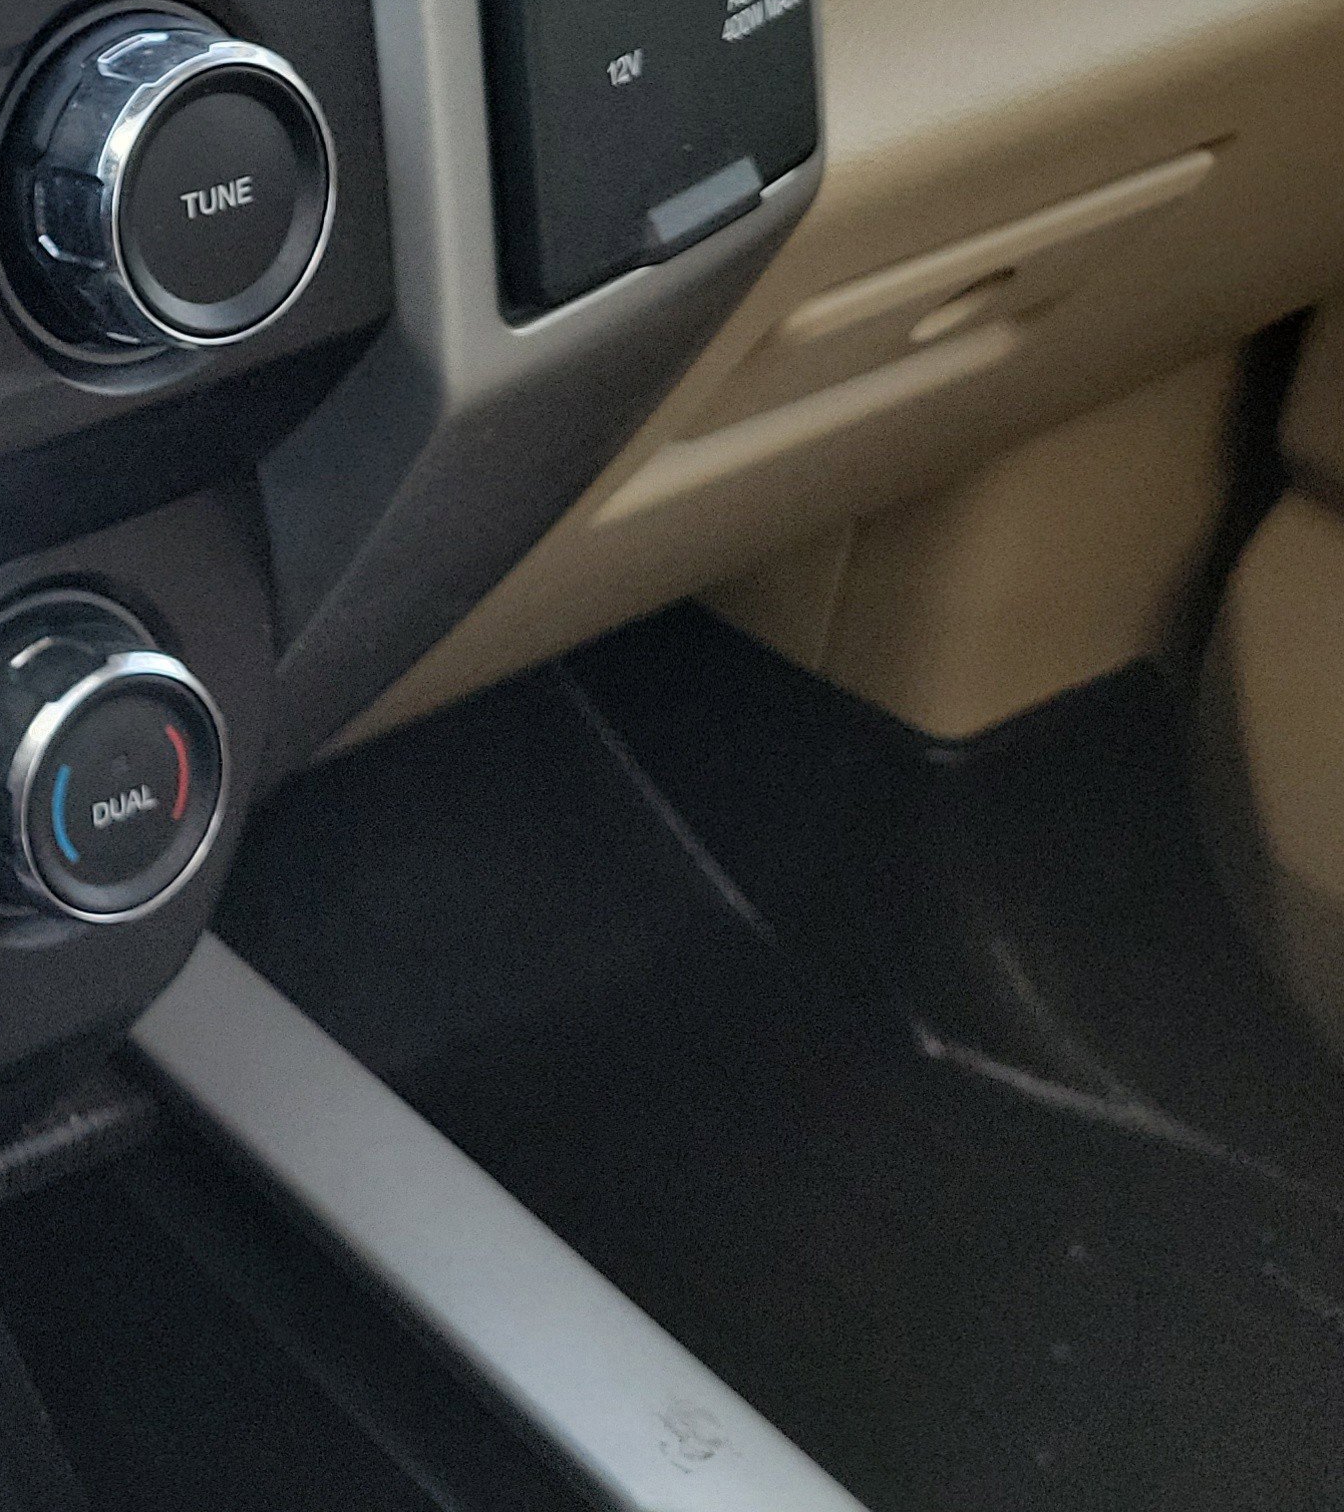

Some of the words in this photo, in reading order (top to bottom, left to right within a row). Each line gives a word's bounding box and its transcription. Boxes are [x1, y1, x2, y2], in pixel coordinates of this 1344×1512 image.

[607, 48, 644, 86] 12V
[180, 175, 254, 220] TUNE
[92, 784, 158, 829] DUAL
